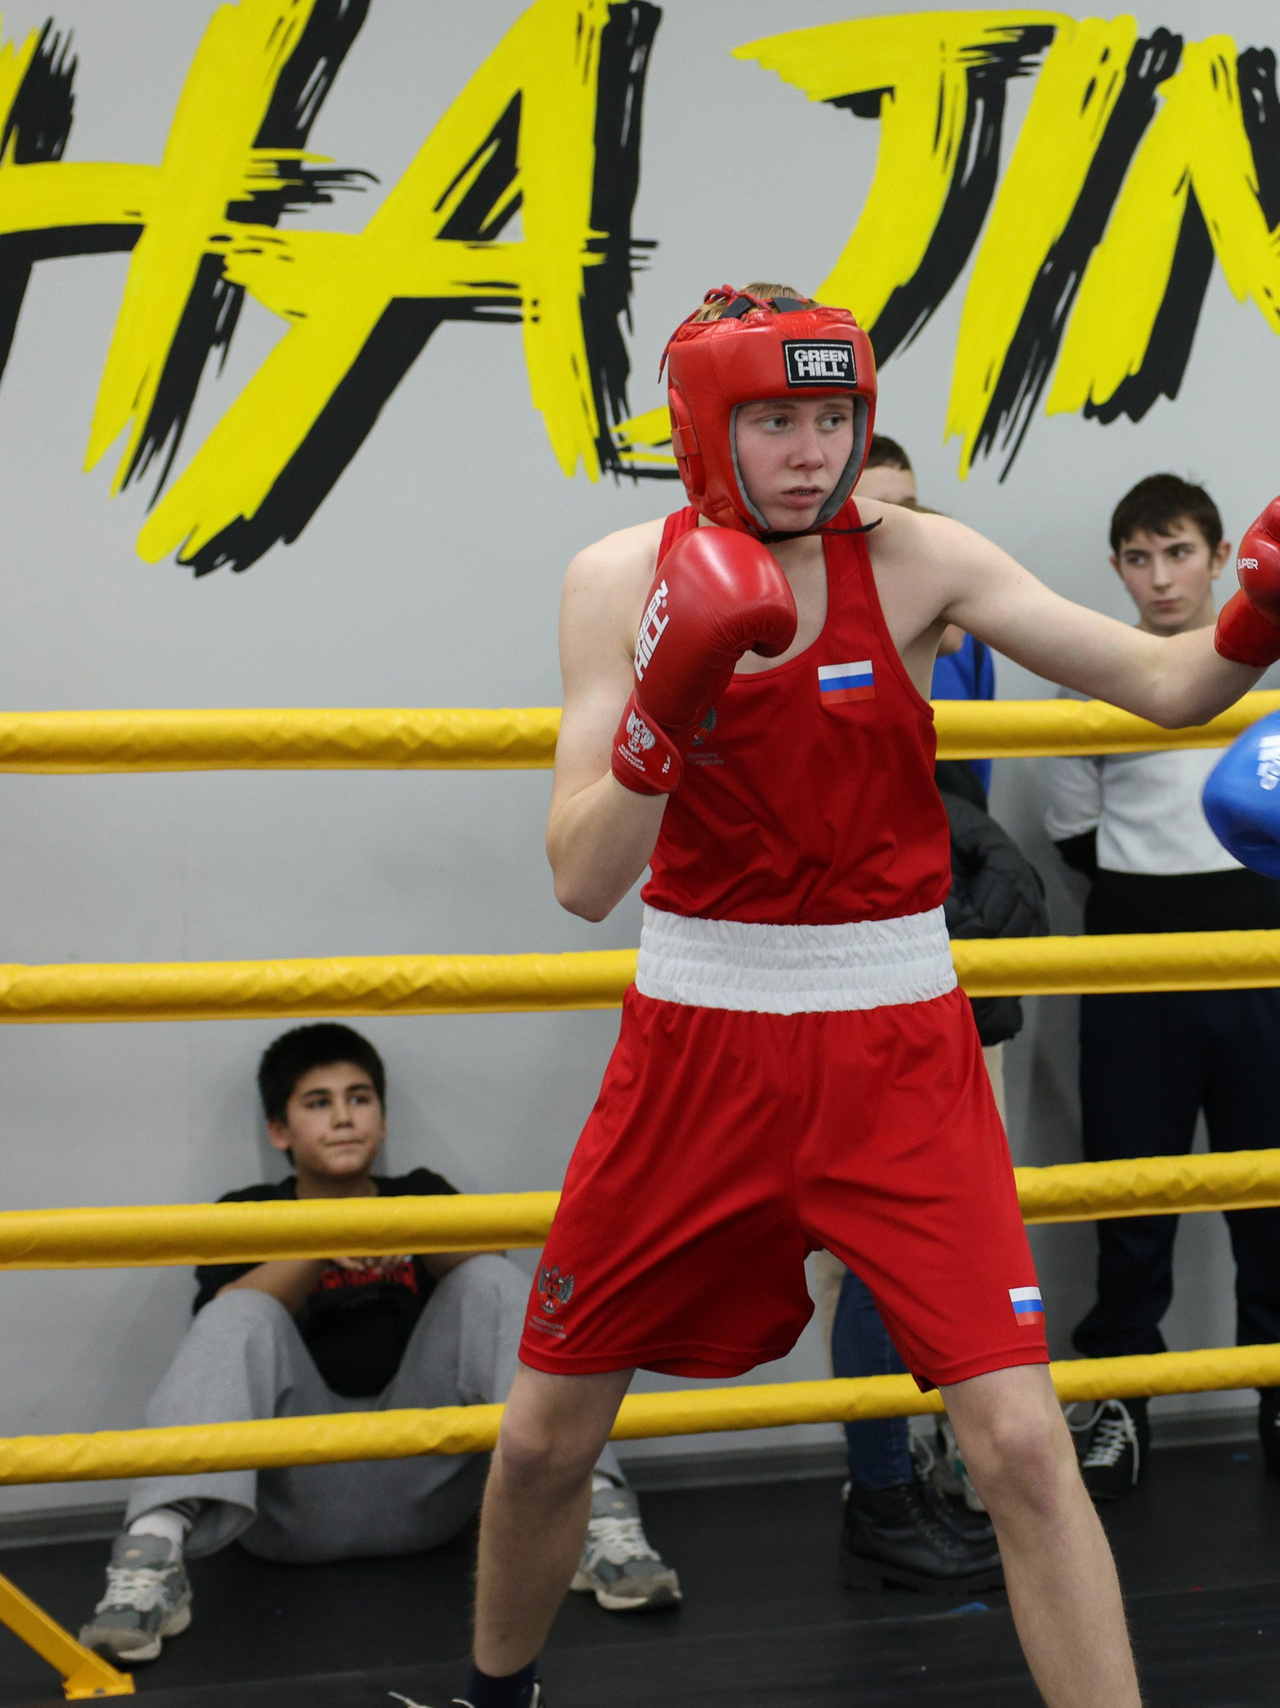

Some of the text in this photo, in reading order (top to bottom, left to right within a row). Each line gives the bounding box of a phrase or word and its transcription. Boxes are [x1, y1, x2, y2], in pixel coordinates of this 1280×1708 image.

[793, 349, 849, 363] GREEN
[797, 361, 845, 377] HILL
[637, 579, 669, 656] REEN
[633, 614, 670, 682] HILL
